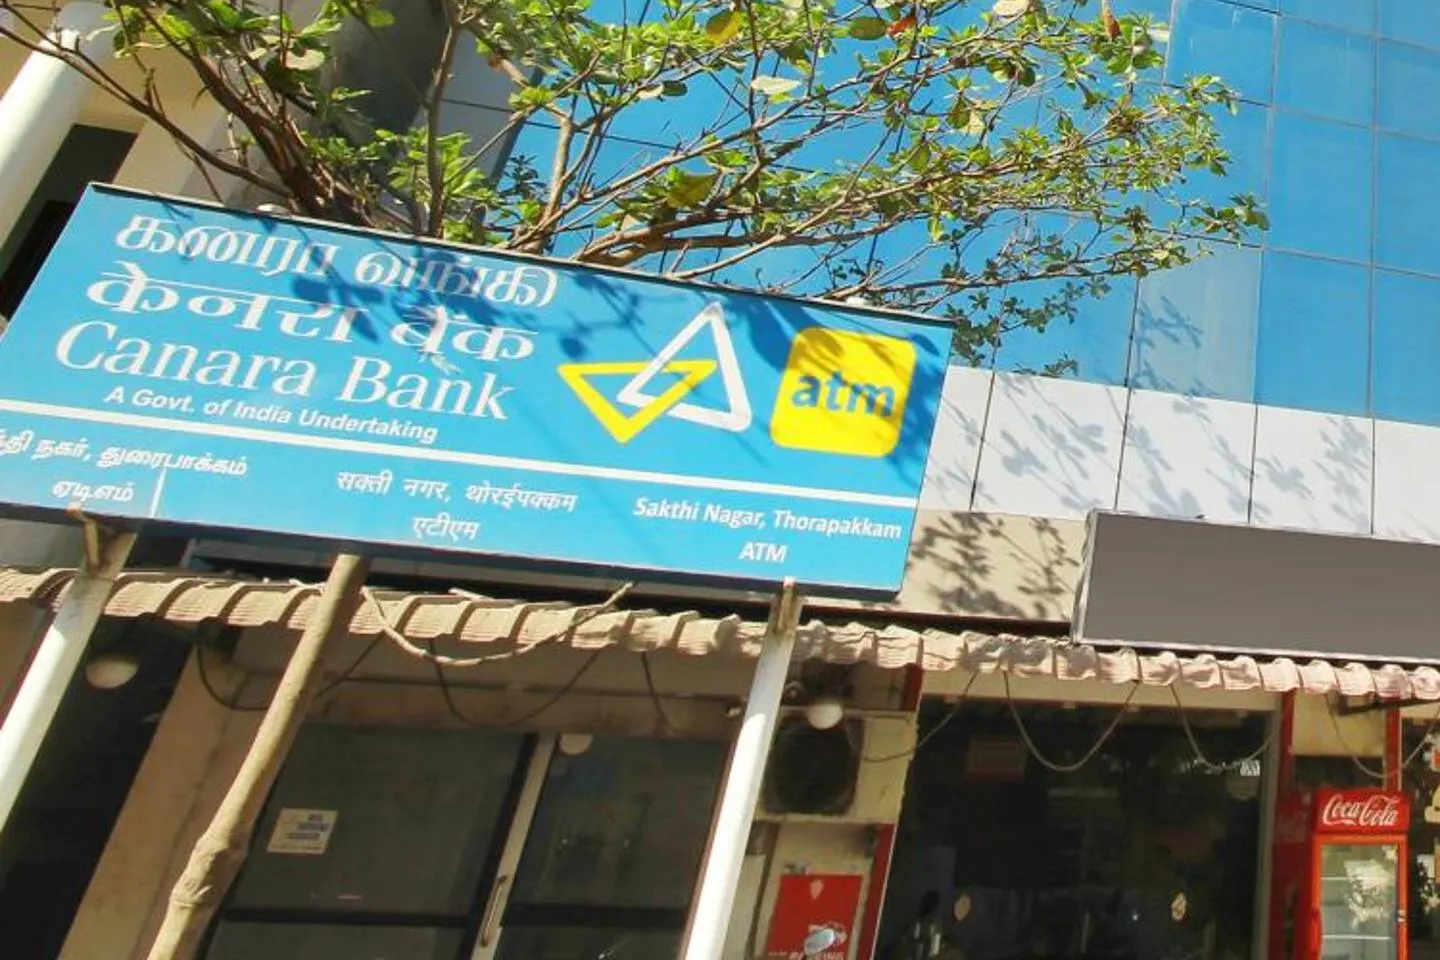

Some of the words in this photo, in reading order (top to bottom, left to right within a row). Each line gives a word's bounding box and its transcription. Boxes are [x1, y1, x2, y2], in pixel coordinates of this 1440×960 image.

[86, 260, 369, 343] केनरा
[390, 304, 540, 362] बैंक
[56, 320, 317, 398] Canara
[337, 355, 516, 420] Bank
[790, 373, 897, 417] atm
[105, 386, 125, 404] A
[132, 388, 195, 416] Govt.
[203, 398, 231, 419] of
[233, 400, 293, 425] India
[299, 408, 439, 444] Undertaking
[633, 496, 700, 522] Sakthi
[702, 504, 767, 531] Nagar,
[772, 509, 902, 540] Thorapakkam
[738, 543, 789, 564] ATM
